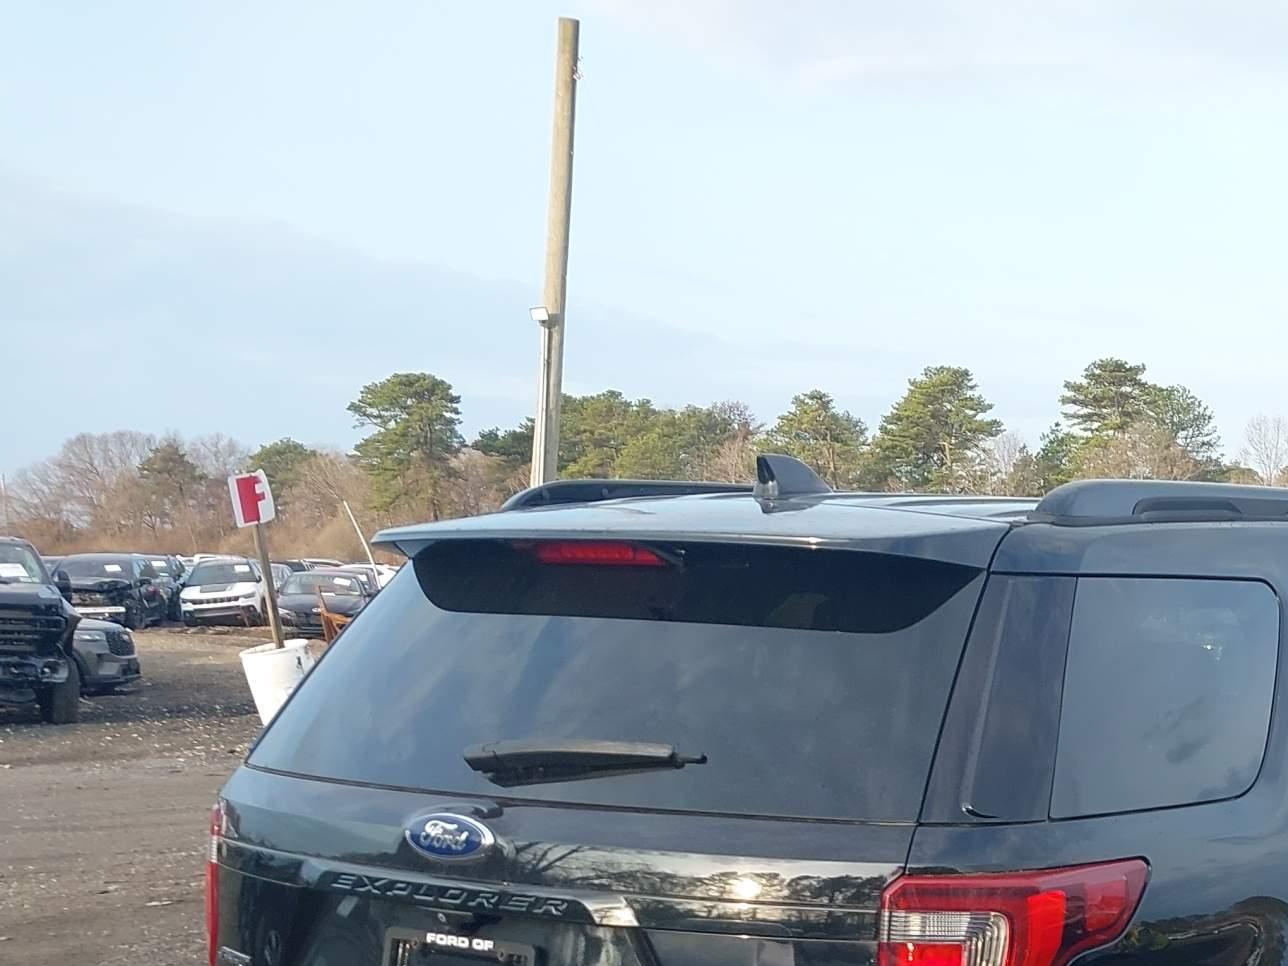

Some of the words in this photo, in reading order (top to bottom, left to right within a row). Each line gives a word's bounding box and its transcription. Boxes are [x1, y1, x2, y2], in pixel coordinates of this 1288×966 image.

[235, 476, 266, 523] F
[420, 820, 470, 850] Ford
[331, 873, 569, 917] EXPLORER
[426, 932, 470, 948] FORD
[472, 938, 495, 951] OF
